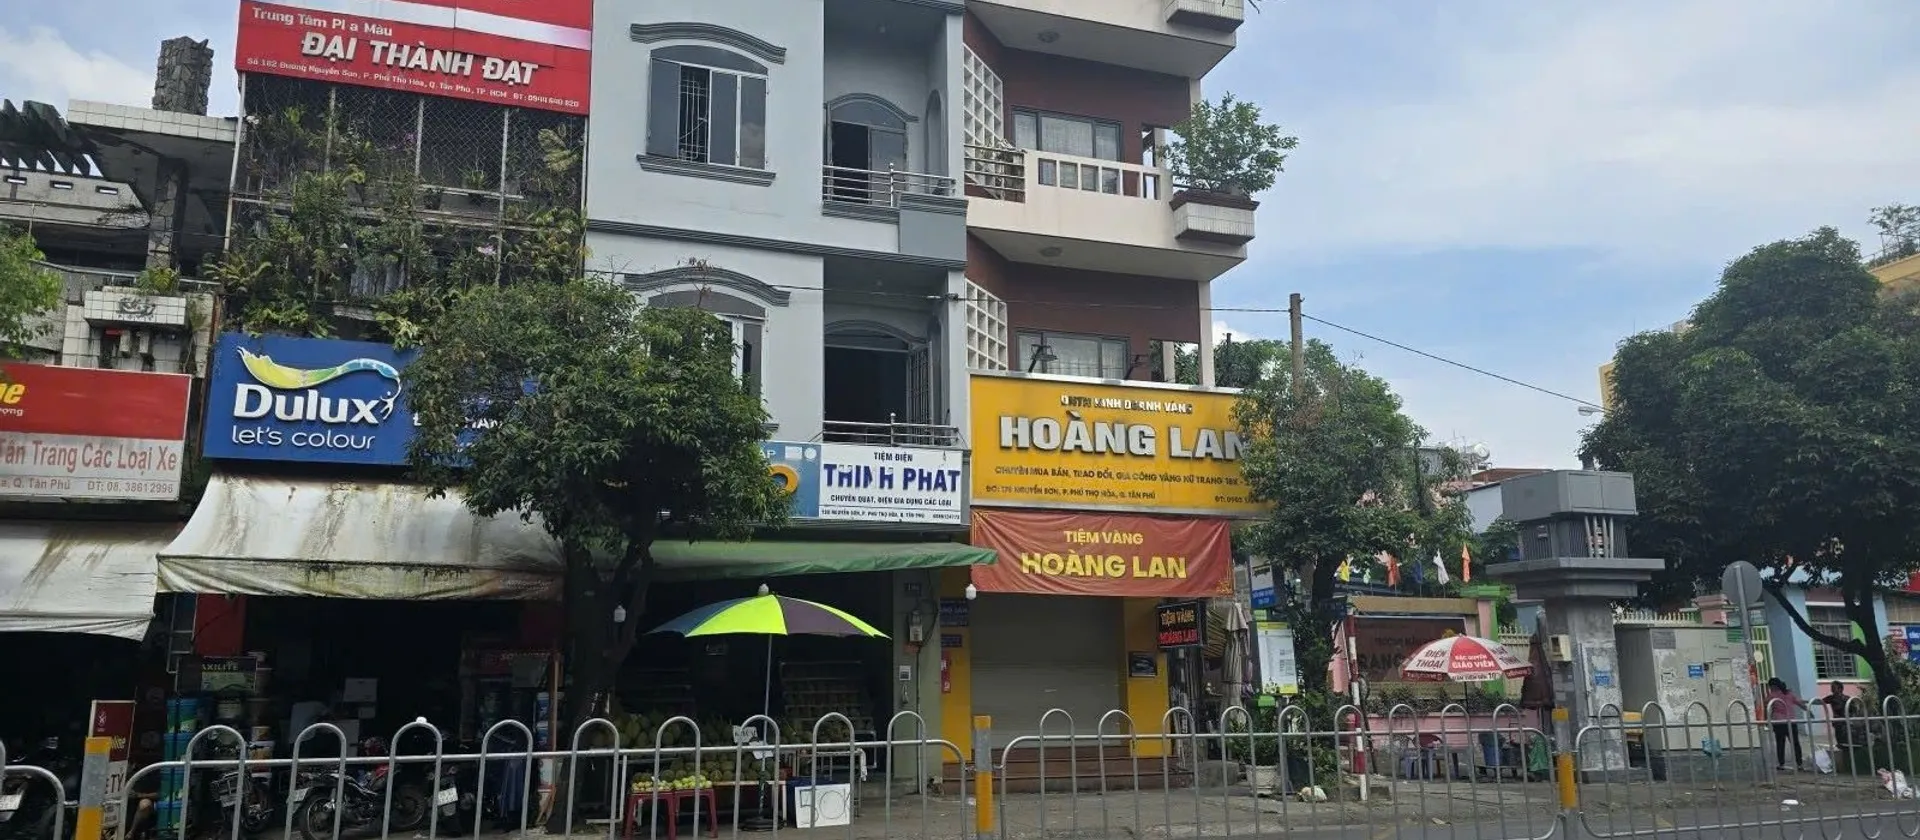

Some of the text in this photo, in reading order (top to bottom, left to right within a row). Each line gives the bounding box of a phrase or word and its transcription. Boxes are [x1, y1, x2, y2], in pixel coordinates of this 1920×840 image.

[252, 7, 294, 26] Trung
[298, 12, 327, 29] Tâm
[364, 23, 393, 37] Màu
[302, 31, 538, 86] ĐẠI THÀNH ĐẠT
[233, 383, 379, 425] Dulux
[231, 425, 376, 450] let's colour
[1000, 410, 1156, 456] HOÀNG
[32, 440, 77, 473] Trang
[81, 442, 113, 469] Các
[117, 444, 152, 475] Loại
[156, 446, 177, 471] Xe
[873, 451, 913, 463] TIỆM ĐIỆN
[1064, 527, 1144, 547] TIỆM VÀNG
[1021, 548, 1187, 579] HOÀNG LAN
